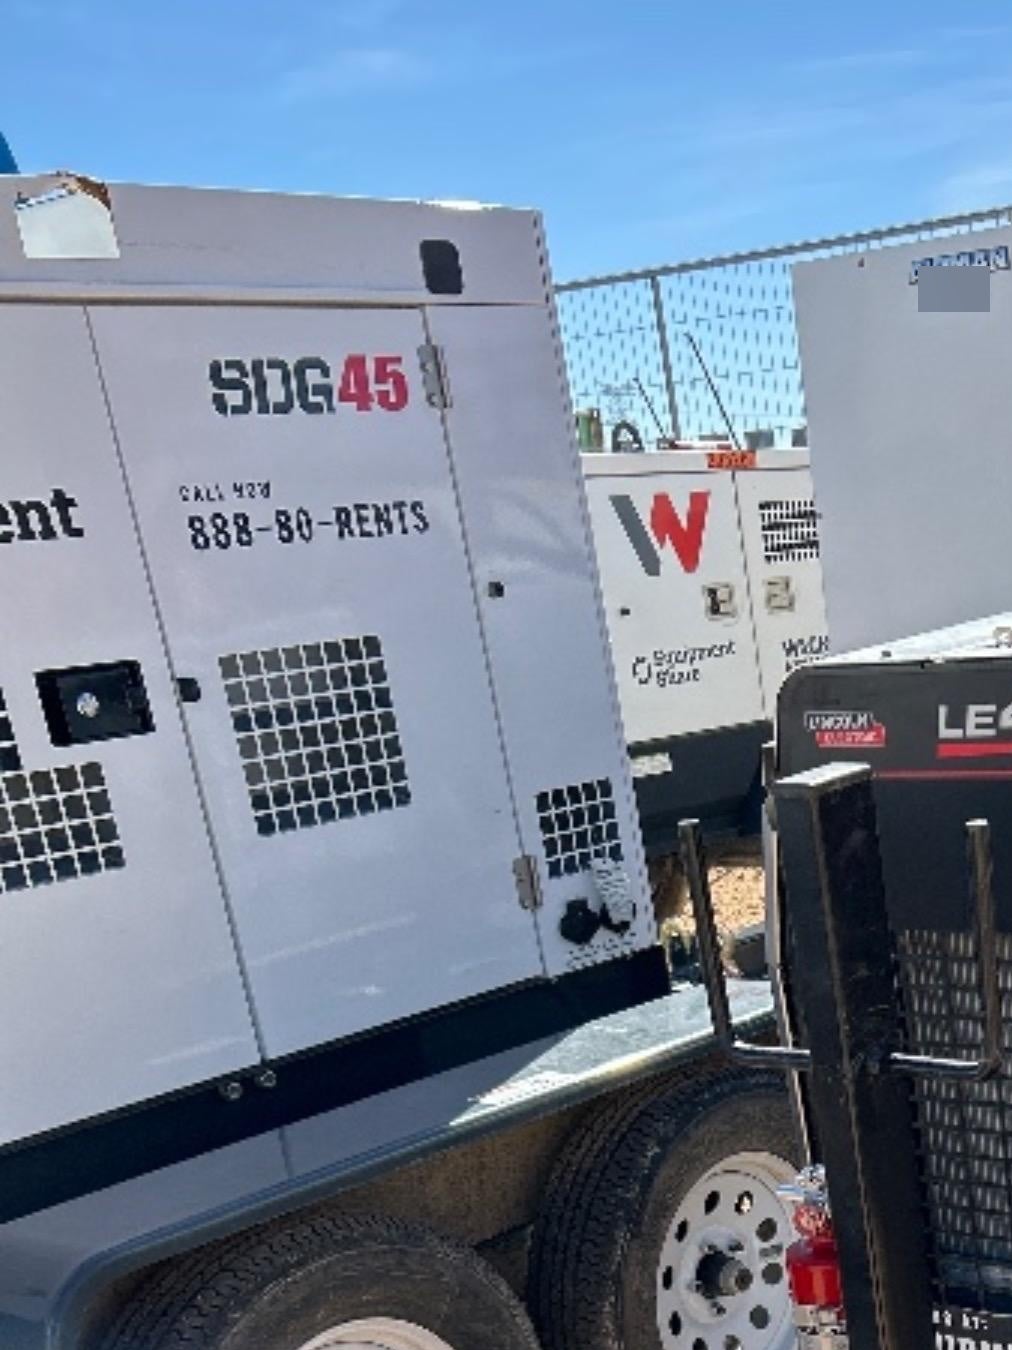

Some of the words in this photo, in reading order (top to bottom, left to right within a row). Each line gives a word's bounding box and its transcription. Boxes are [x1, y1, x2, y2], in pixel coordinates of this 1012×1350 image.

[910, 246, 1011, 285] AMAN
[208, 354, 410, 416] SDG45
[187, 499, 430, 551] 888-80-RENTS
